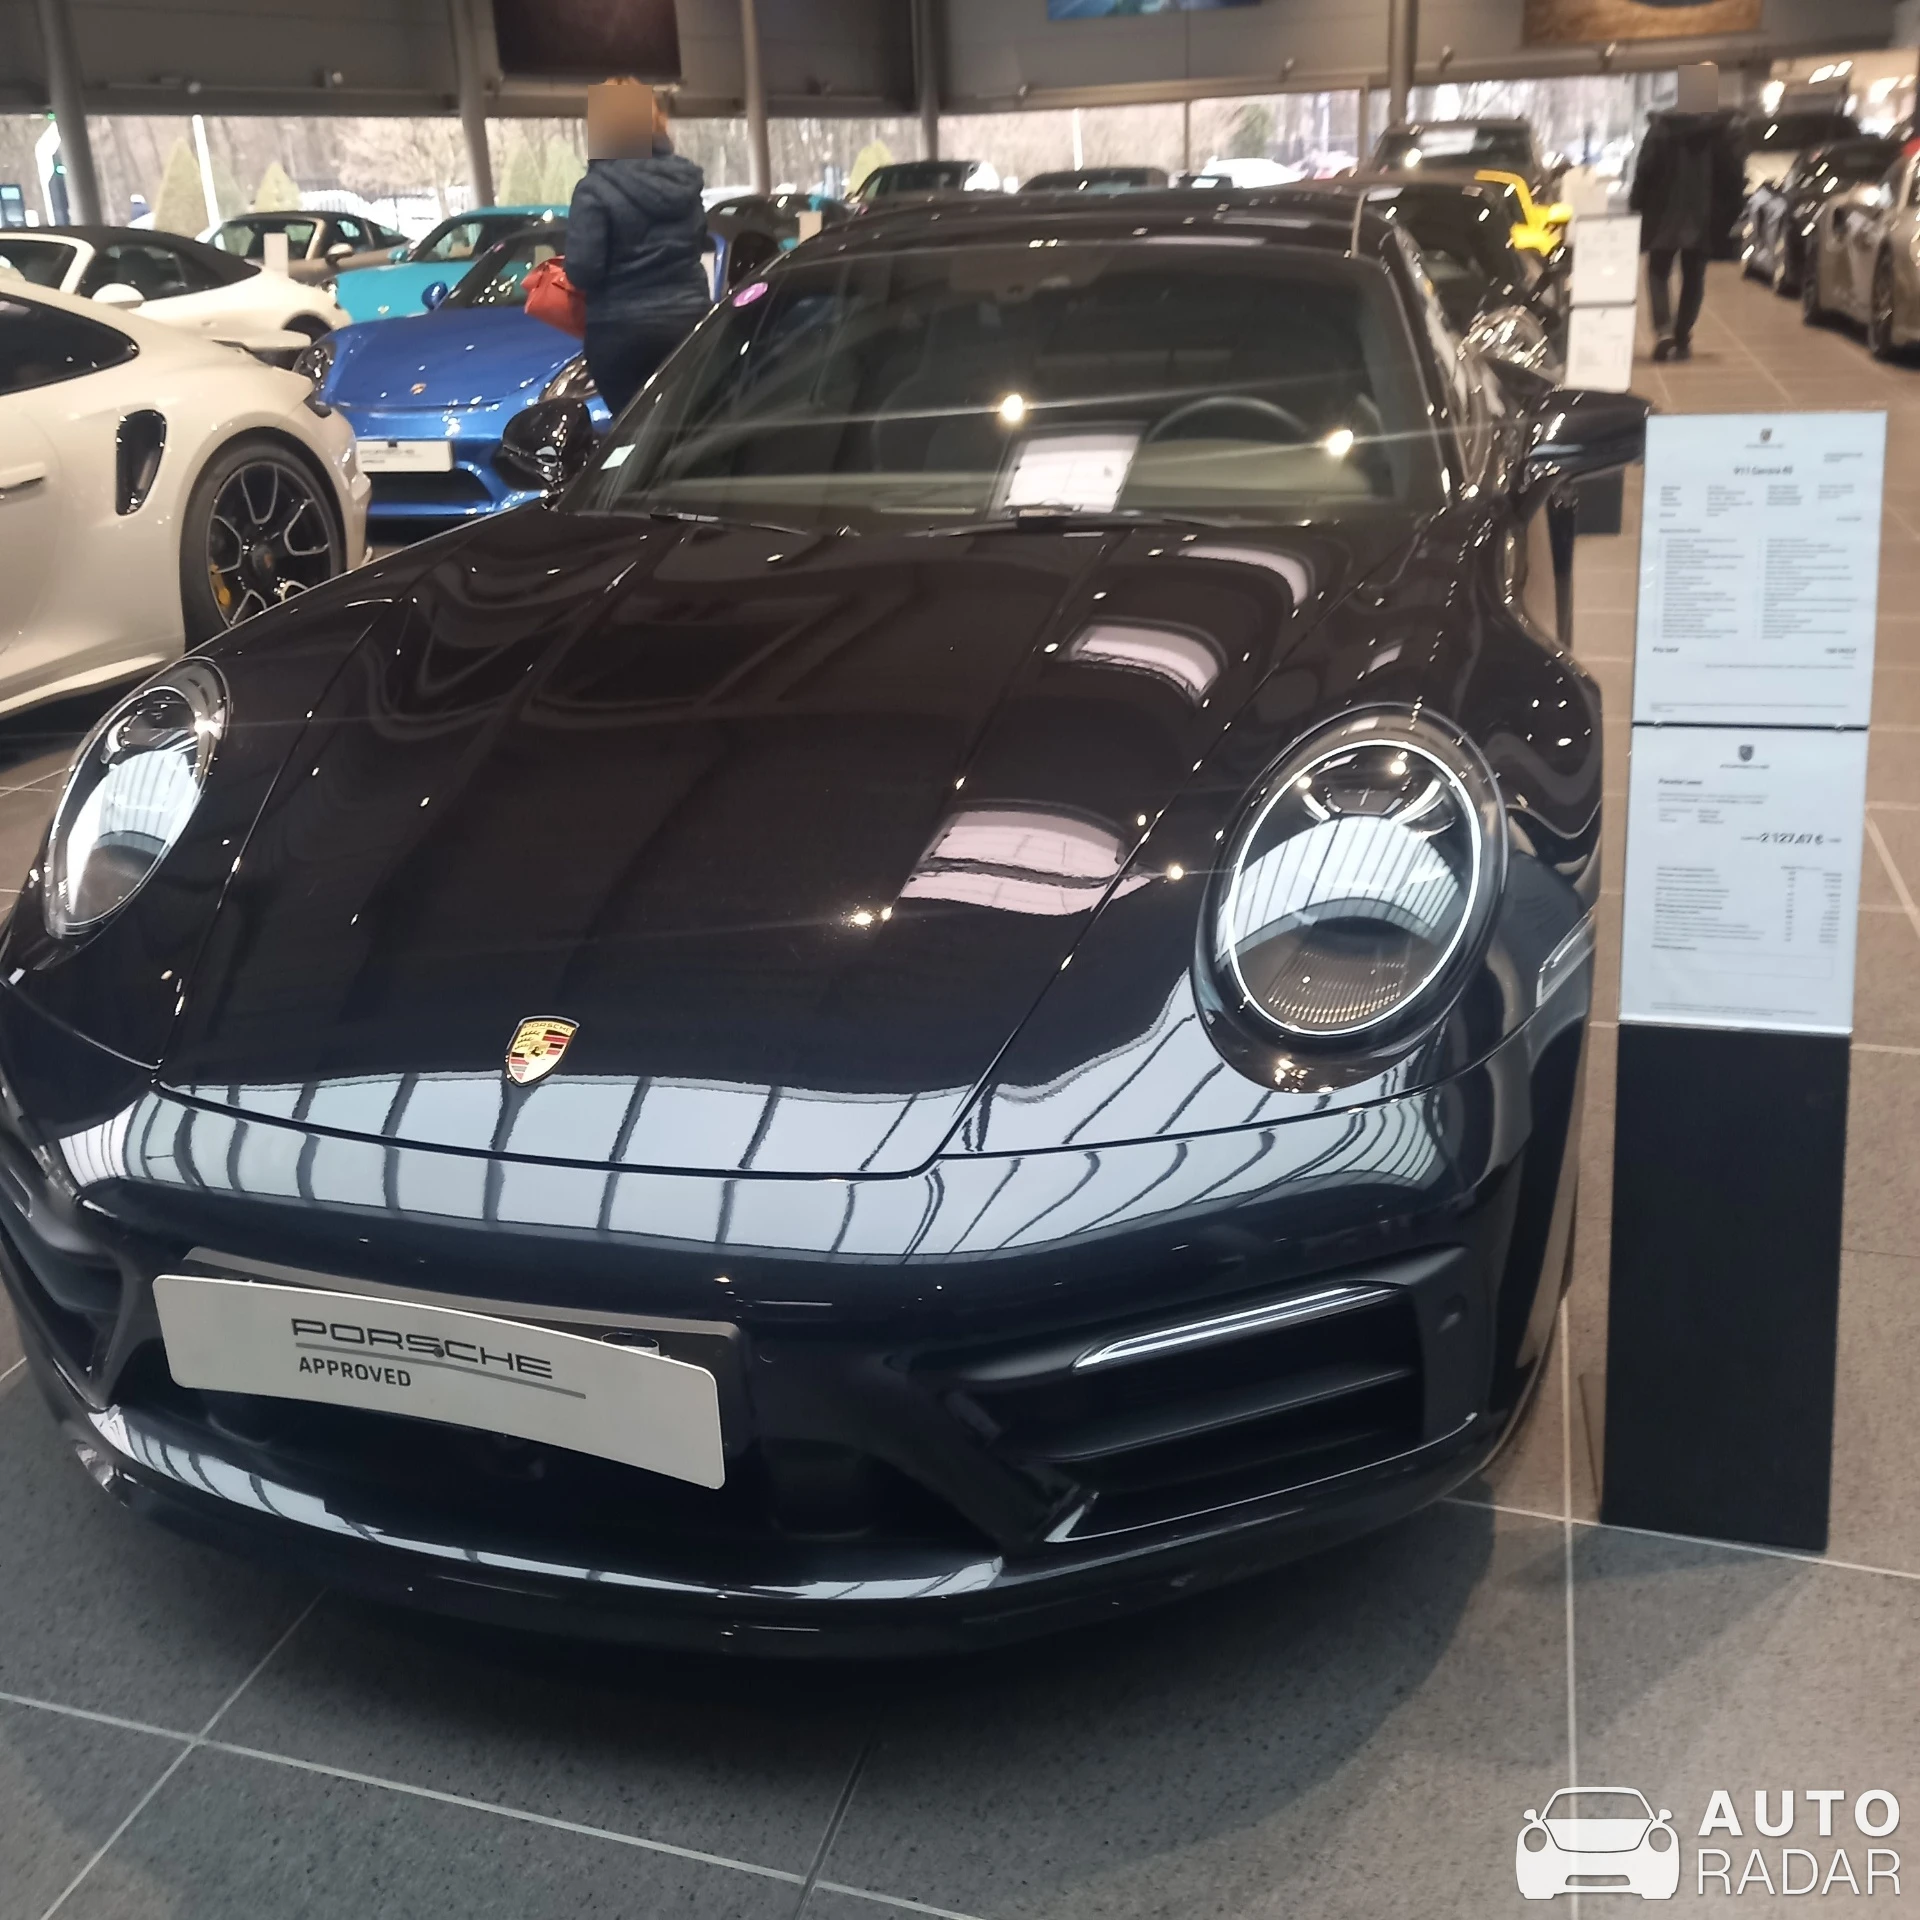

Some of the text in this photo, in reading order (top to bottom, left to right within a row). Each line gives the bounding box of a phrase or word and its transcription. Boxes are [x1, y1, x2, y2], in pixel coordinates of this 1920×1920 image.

[523, 1022, 571, 1034] PORSCHE
[291, 1318, 553, 1379] PORSCHE
[299, 1356, 412, 1387] APPROVED
